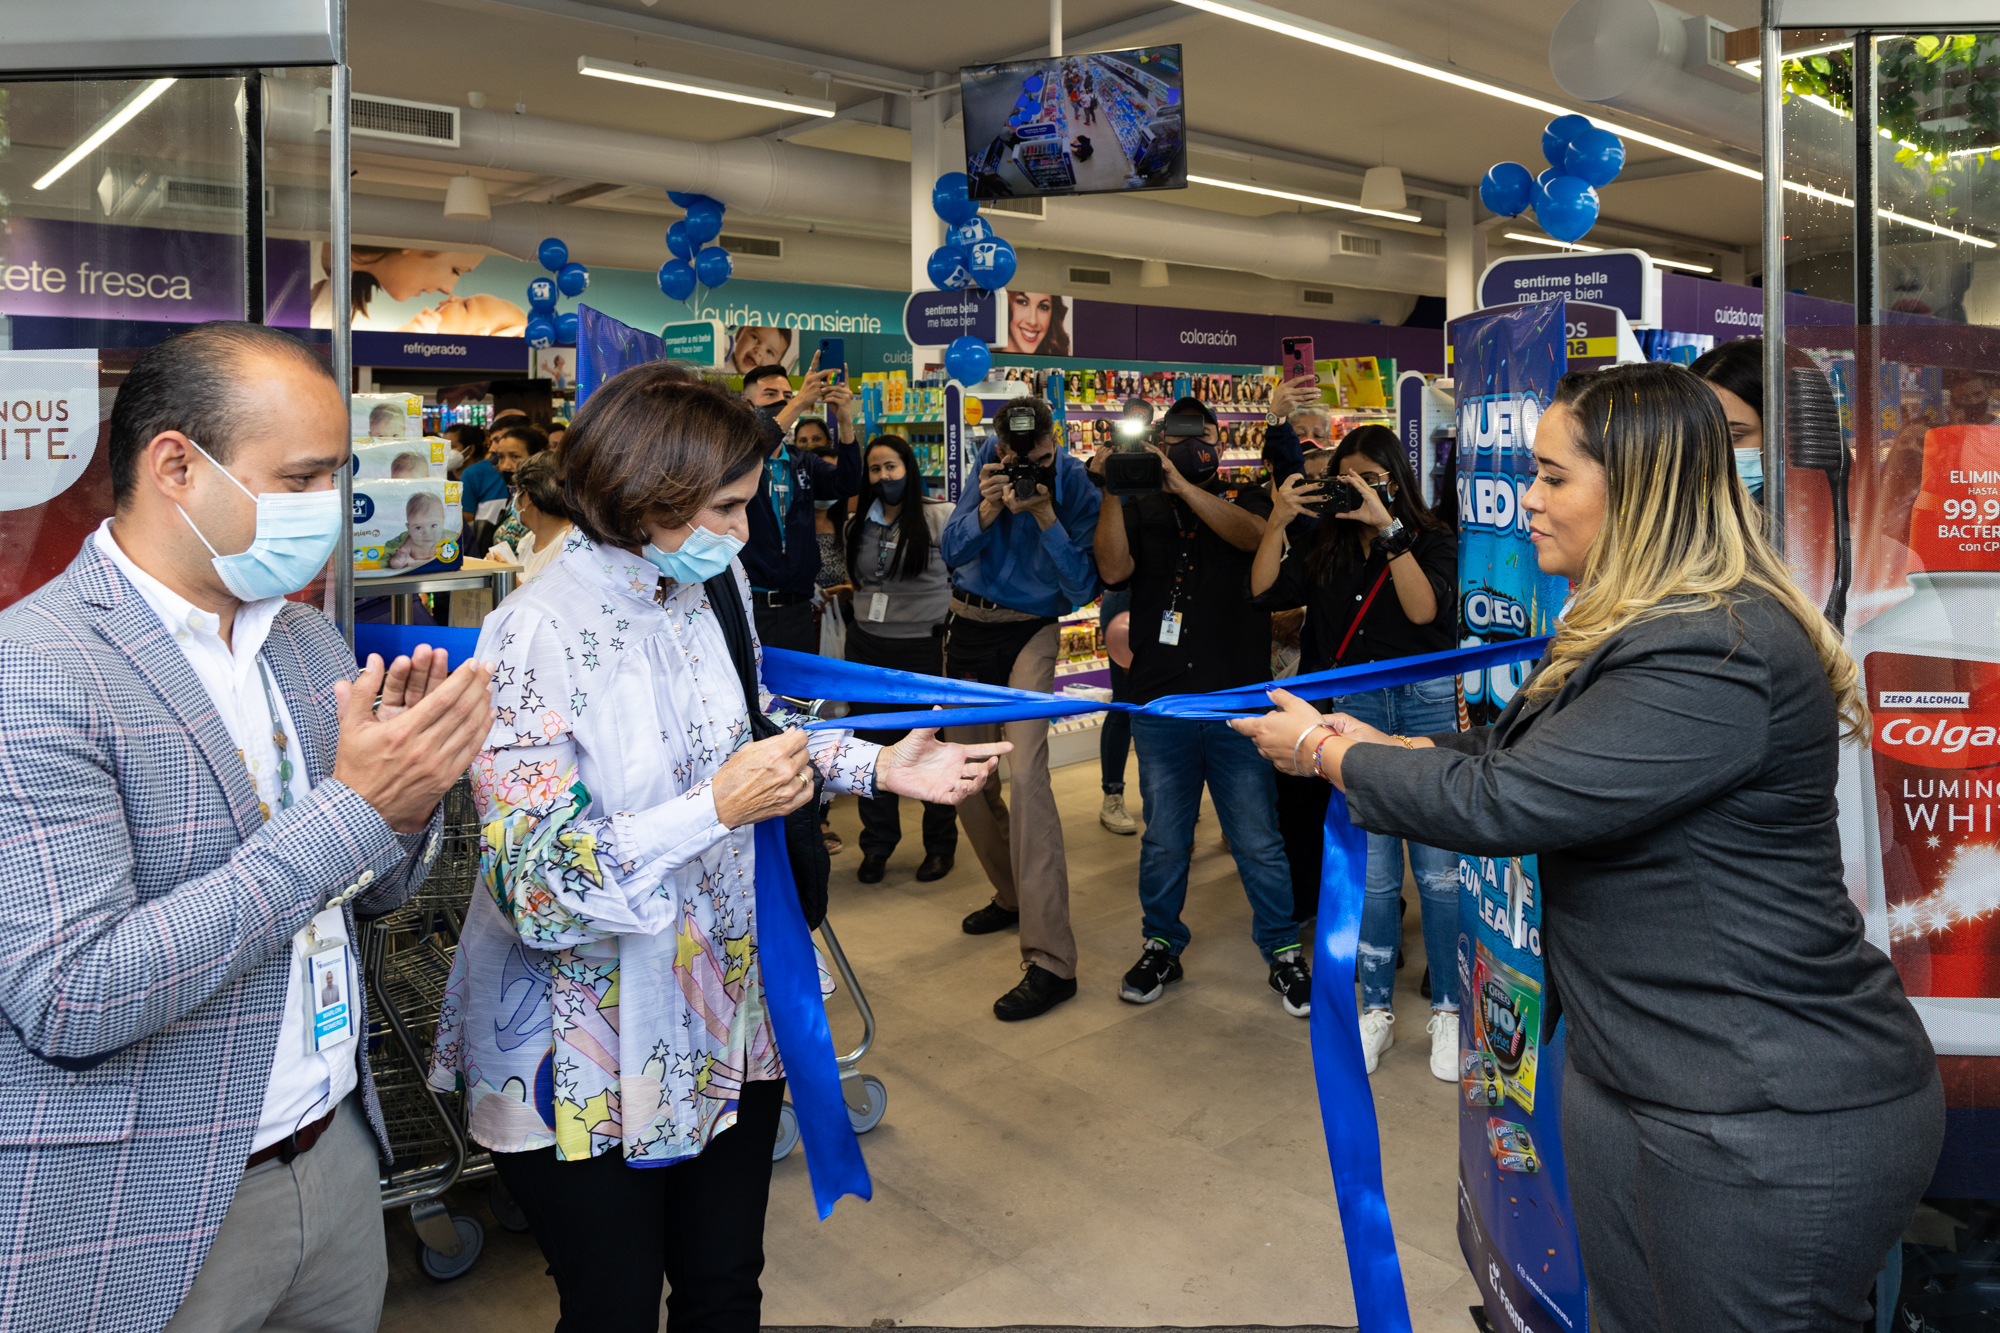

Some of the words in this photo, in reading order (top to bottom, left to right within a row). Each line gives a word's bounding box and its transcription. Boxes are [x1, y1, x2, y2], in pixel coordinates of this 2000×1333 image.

[77, 262, 192, 300] fresca
[1514, 274, 1571, 289] sentirme
[1574, 272, 1608, 286] bella
[1518, 292, 1538, 302] me
[1575, 287, 1603, 300] bien
[925, 304, 958, 316] sentirme
[959, 302, 979, 314] bella
[1715, 306, 1748, 326] cuidado
[784, 310, 881, 334] consiente
[927, 319, 939, 328] me
[940, 317, 958, 327] hace
[960, 316, 976, 326] bien
[1180, 328, 1237, 346] coloración
[404, 341, 467, 356] refrigerados
[949, 424, 957, 460] horas
[949, 464, 957, 479] 24
[1968, 487, 1998, 495] HASTA
[1958, 543, 1981, 552] con
[1883, 695, 1913, 704] ZERO
[1915, 695, 1965, 704] ALCOHOL
[1881, 718, 2000, 753] Colga
[1903, 803, 2000, 833] WHI
[1488, 983, 1513, 1008] OREO
[1500, 1286, 1535, 1333] FARM
